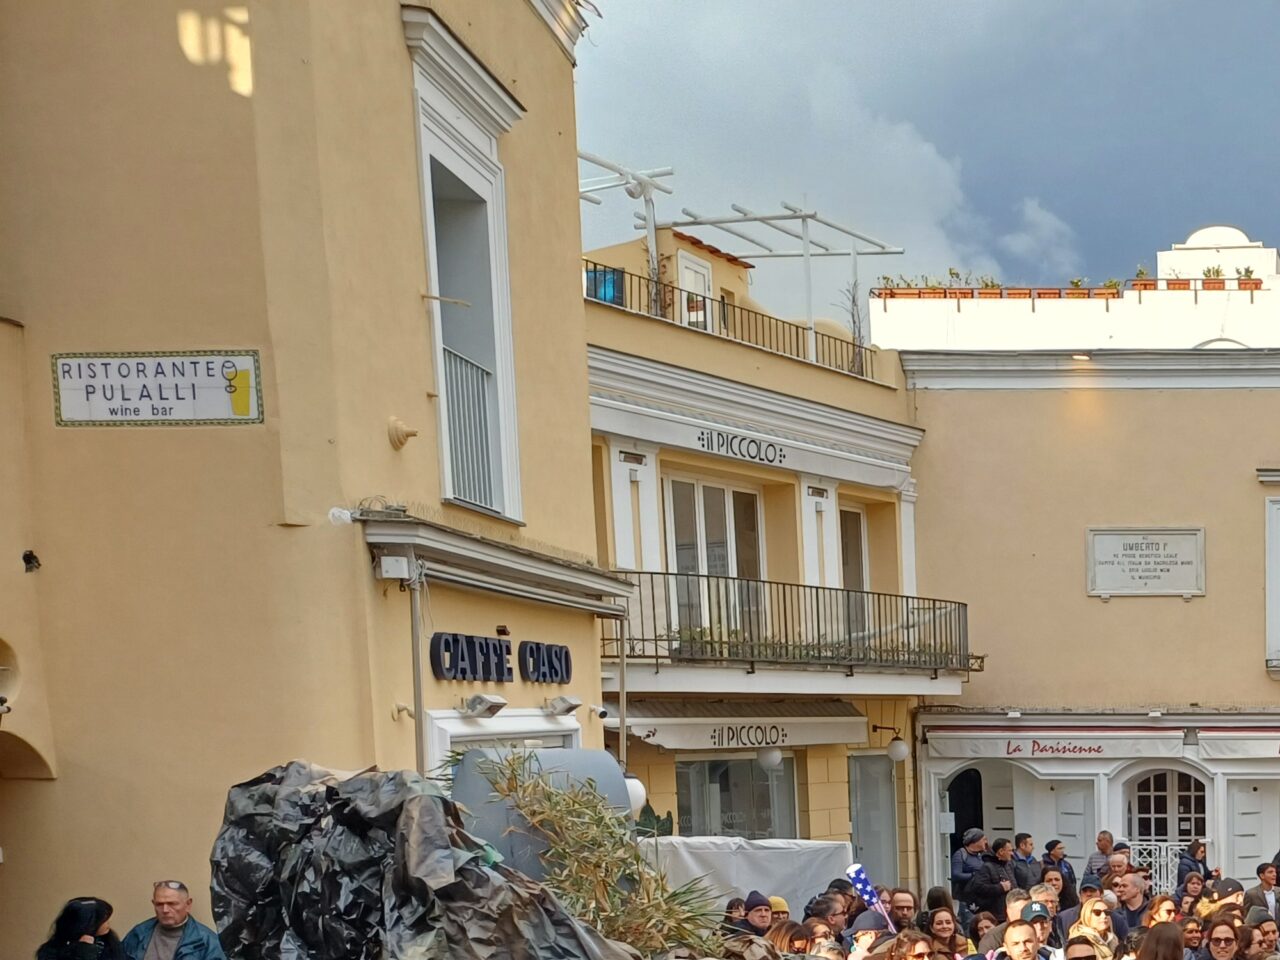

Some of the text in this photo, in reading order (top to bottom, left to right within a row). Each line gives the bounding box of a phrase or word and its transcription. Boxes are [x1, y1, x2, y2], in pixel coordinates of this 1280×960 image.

[61, 361, 215, 379] RISTORANTE
[85, 383, 196, 401] PULALLI
[108, 404, 173, 416] wine bar
[717, 432, 776, 463] PICCOLO
[518, 641, 572, 684] CASO
[728, 725, 779, 746] PICCOLO
[1006, 740, 1103, 756] La Parisienne
